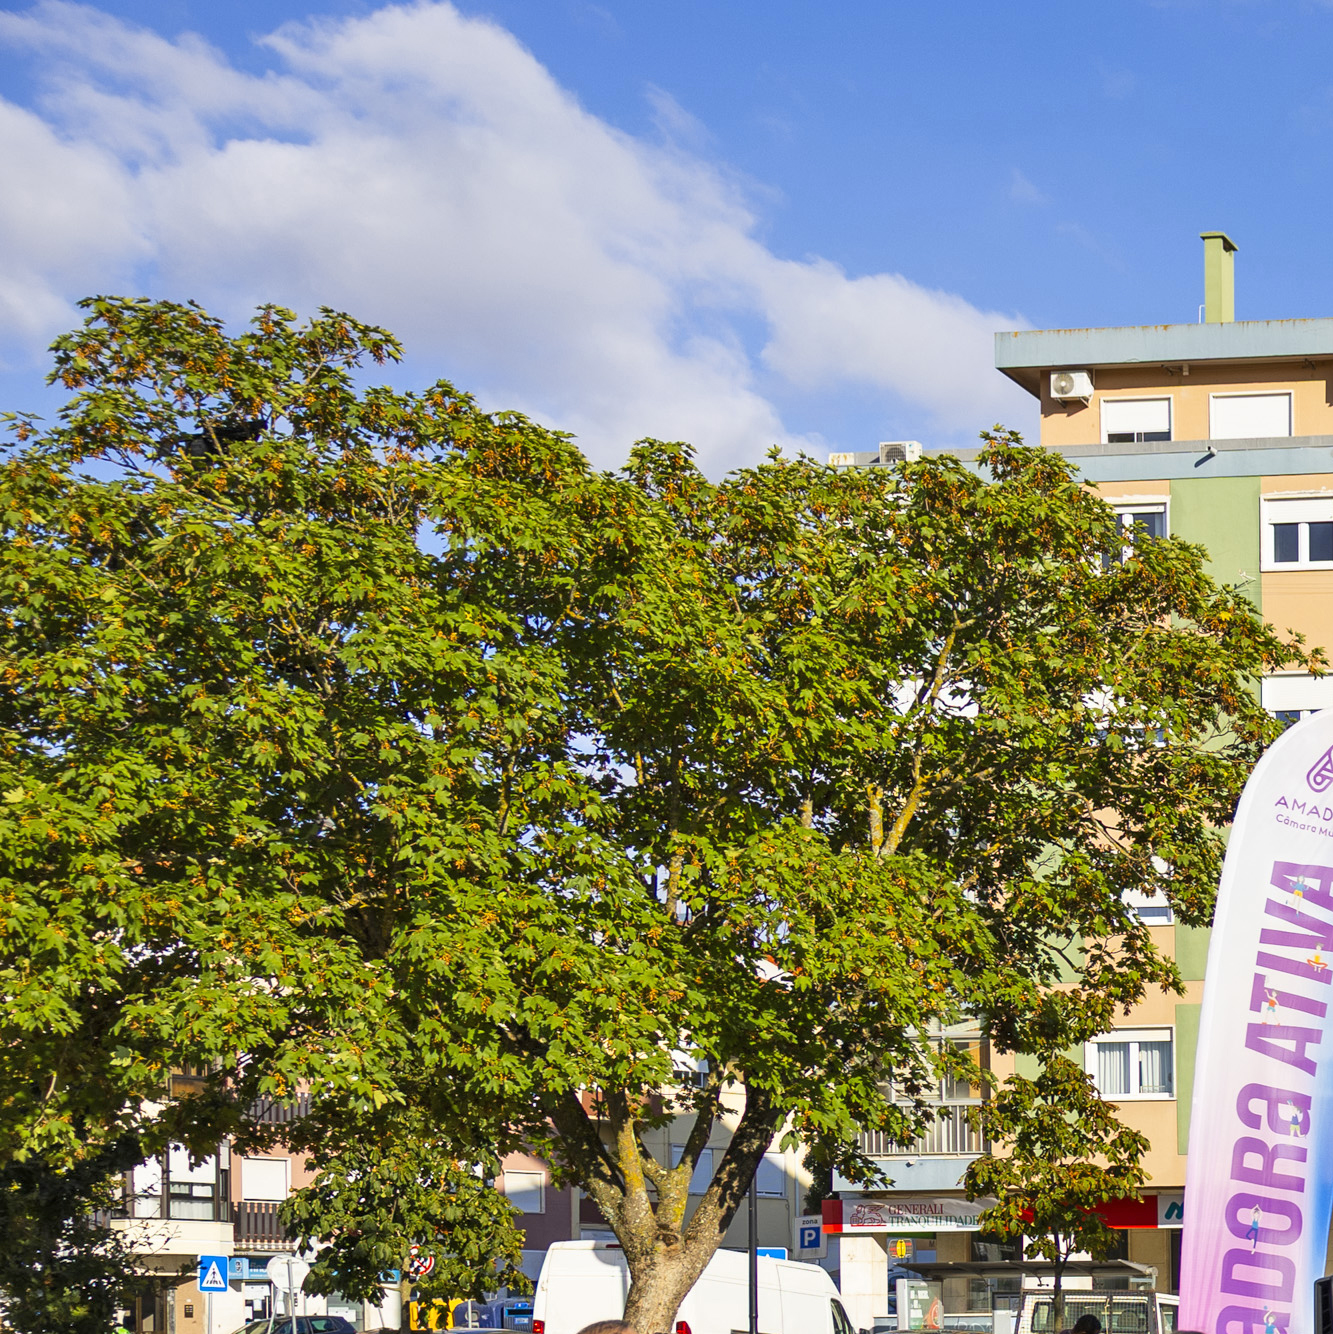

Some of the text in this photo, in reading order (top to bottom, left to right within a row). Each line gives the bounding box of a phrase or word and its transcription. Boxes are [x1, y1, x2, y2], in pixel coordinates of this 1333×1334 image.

[1276, 814, 1317, 832] Câmara
[888, 1203, 944, 1215] GENERALI
[888, 1215, 979, 1228] TRANQUILIDADE
